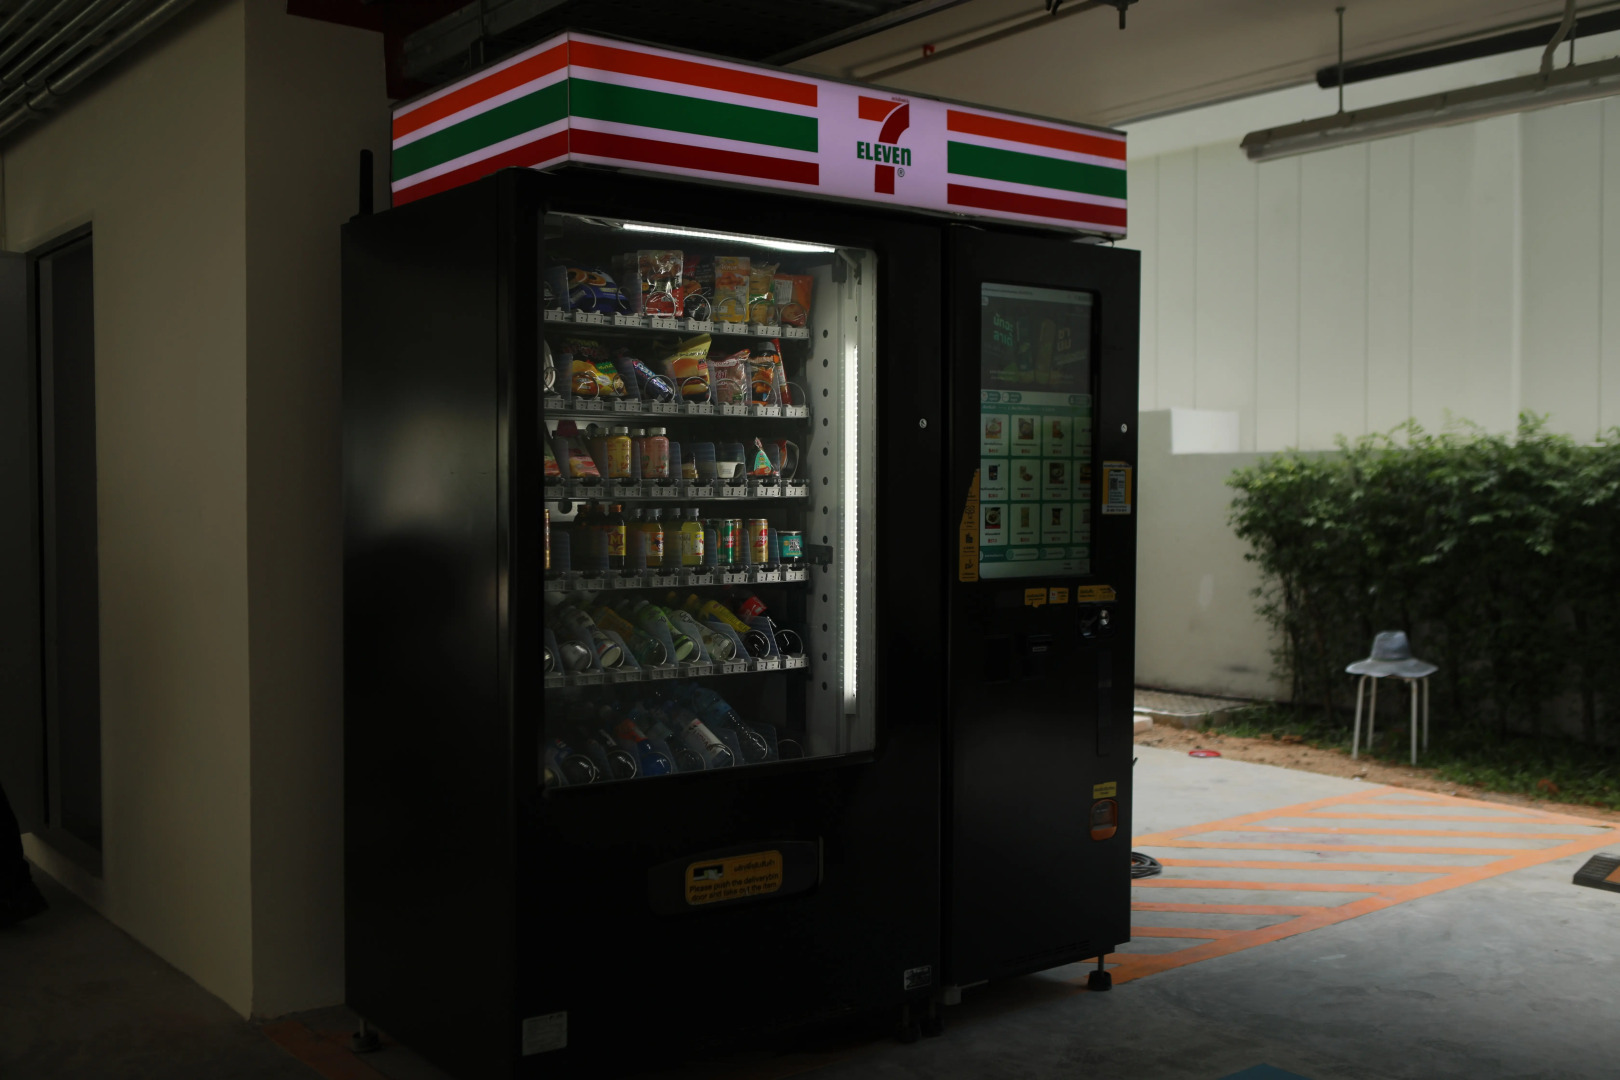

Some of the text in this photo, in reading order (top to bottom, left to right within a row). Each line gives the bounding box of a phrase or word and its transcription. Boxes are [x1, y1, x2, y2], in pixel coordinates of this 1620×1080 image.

[858, 95, 910, 195] 7
[610, 535, 621, 545] M
[689, 885, 712, 893] Please
[713, 881, 731, 891] push
[709, 890, 722, 899] and
[739, 886, 750, 894] out
[751, 883, 762, 891] the
